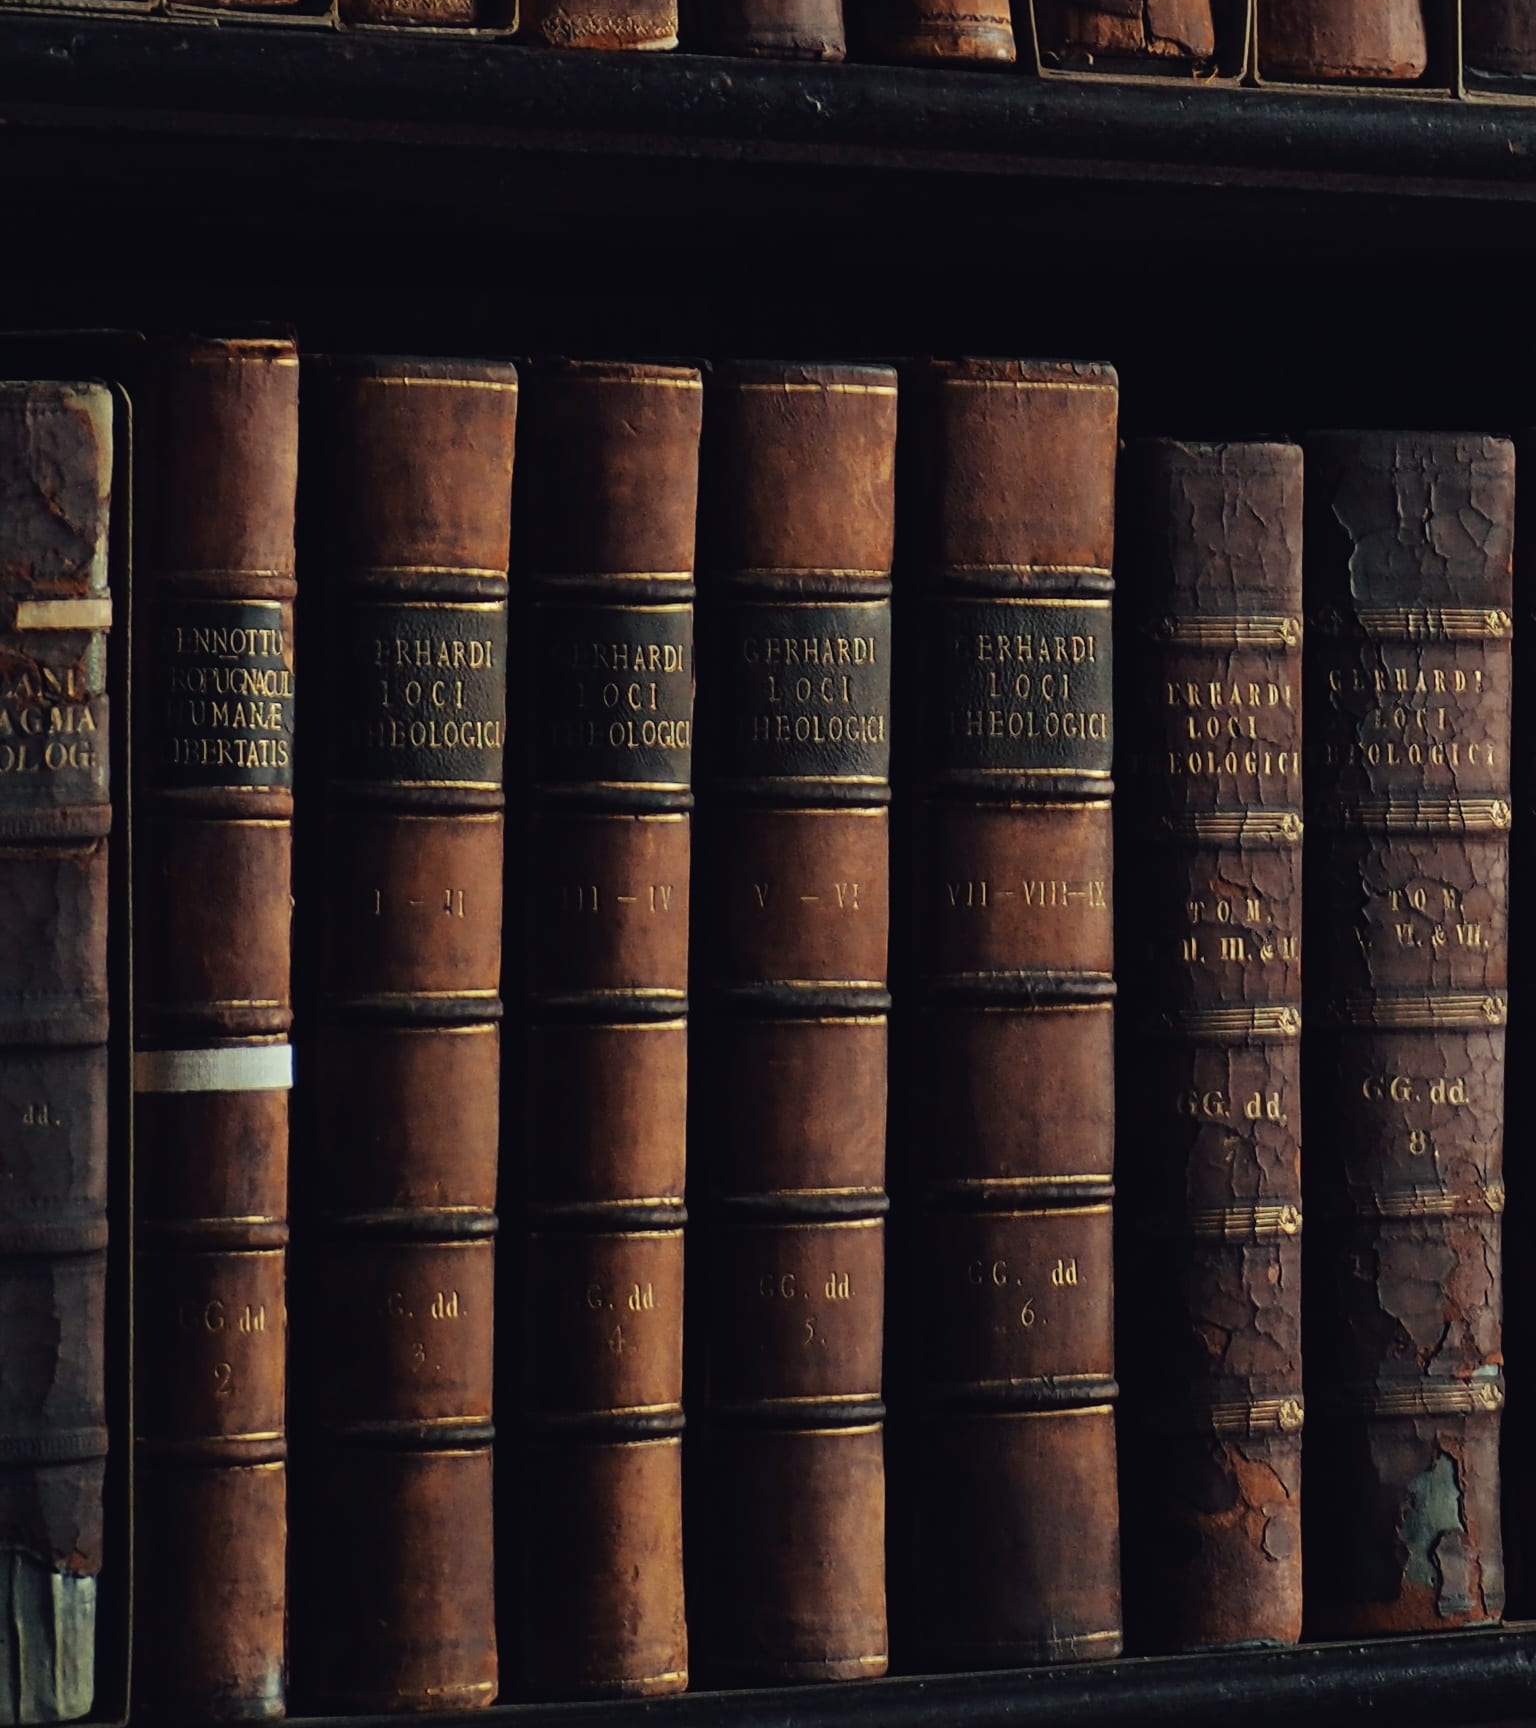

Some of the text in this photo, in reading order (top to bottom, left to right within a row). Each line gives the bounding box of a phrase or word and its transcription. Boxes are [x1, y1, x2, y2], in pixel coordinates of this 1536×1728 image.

[972, 634, 1097, 664] ERHARDI
[380, 679, 465, 710] LOCI
[769, 676, 851, 704] LOCI
[990, 672, 1071, 702] LOCI
[1167, 682, 1292, 707] ERHARDI
[366, 718, 503, 751] HEOLOGICI
[753, 715, 886, 744] HEOLOGICI
[1187, 715, 1258, 740] LOCI
[173, 736, 290, 768] IBERTATIS
[1169, 751, 1301, 776] EOLOGICI
[1362, 1076, 1471, 1106] GG. dd.
[1244, 1091, 1288, 1124] dd.
[1051, 1259, 1087, 1287] dd.
[431, 1291, 468, 1320] dd.
[1020, 1300, 1049, 1328] 6.
[213, 1363, 233, 1398] 2
